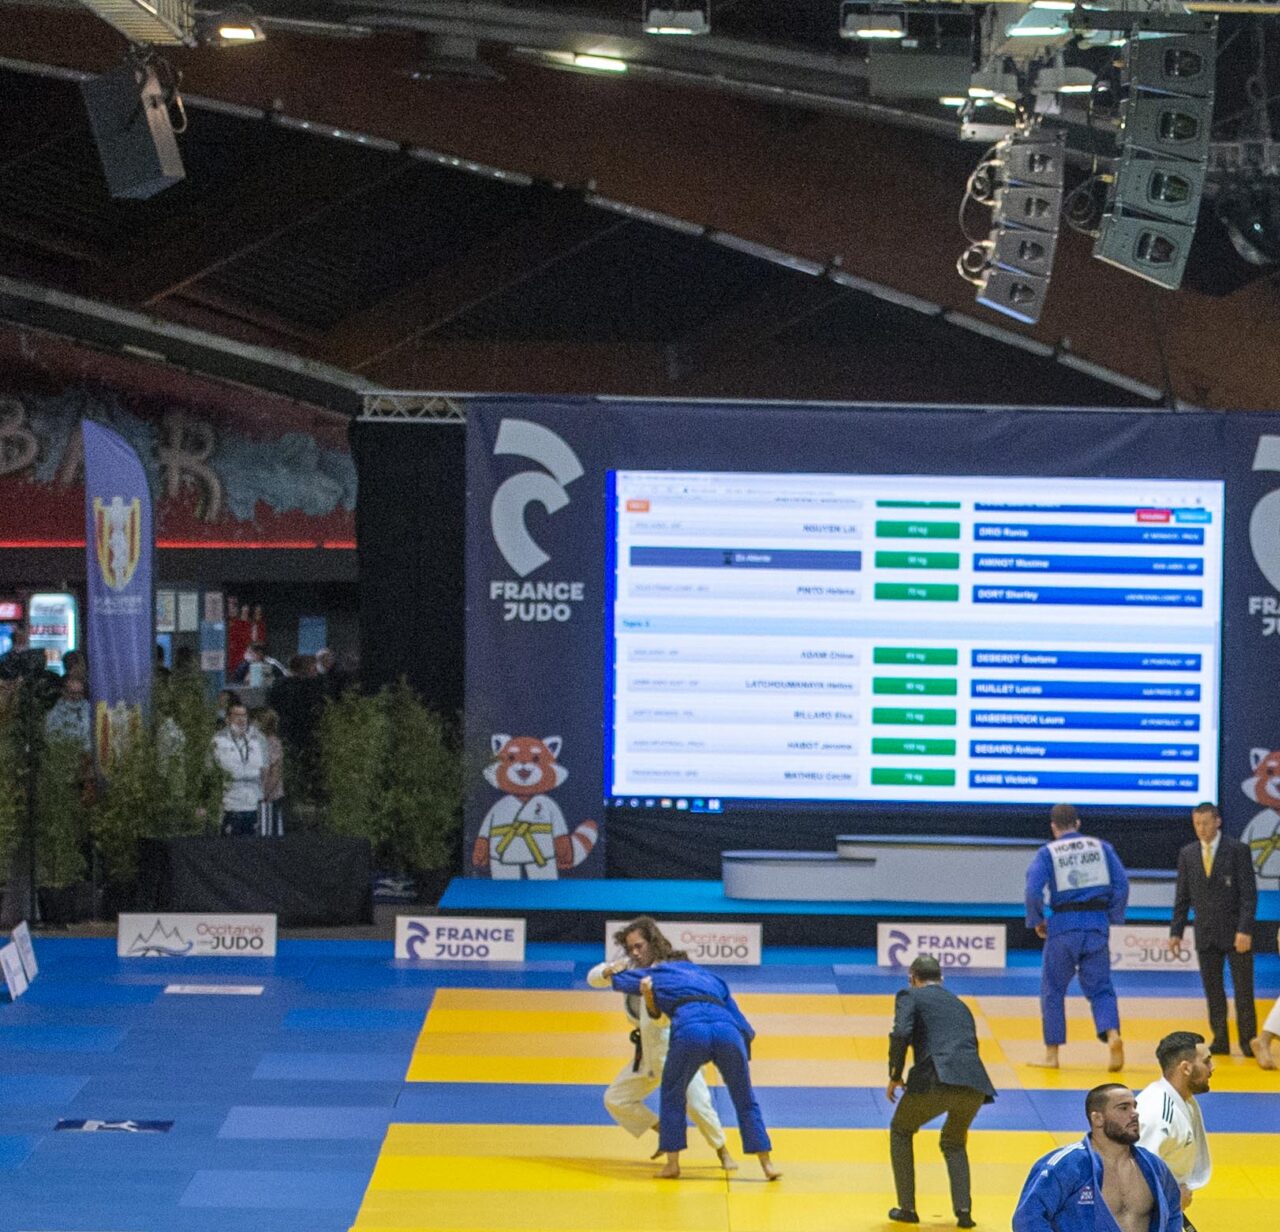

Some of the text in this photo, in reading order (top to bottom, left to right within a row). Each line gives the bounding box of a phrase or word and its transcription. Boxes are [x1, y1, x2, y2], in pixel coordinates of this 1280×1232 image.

[490, 582, 585, 600] FRANCE
[504, 602, 571, 621] JUDO
[197, 923, 264, 936] Occitanie
[436, 927, 515, 942] FRANCE
[211, 936, 264, 950] JUDO
[681, 931, 748, 944] Occitanie
[918, 936, 996, 950] FRANCE
[1125, 936, 1191, 948] Occitae
[436, 944, 490, 957] JUDO
[696, 945, 748, 958] JUDO
[1139, 948, 1191, 962] JUDO
